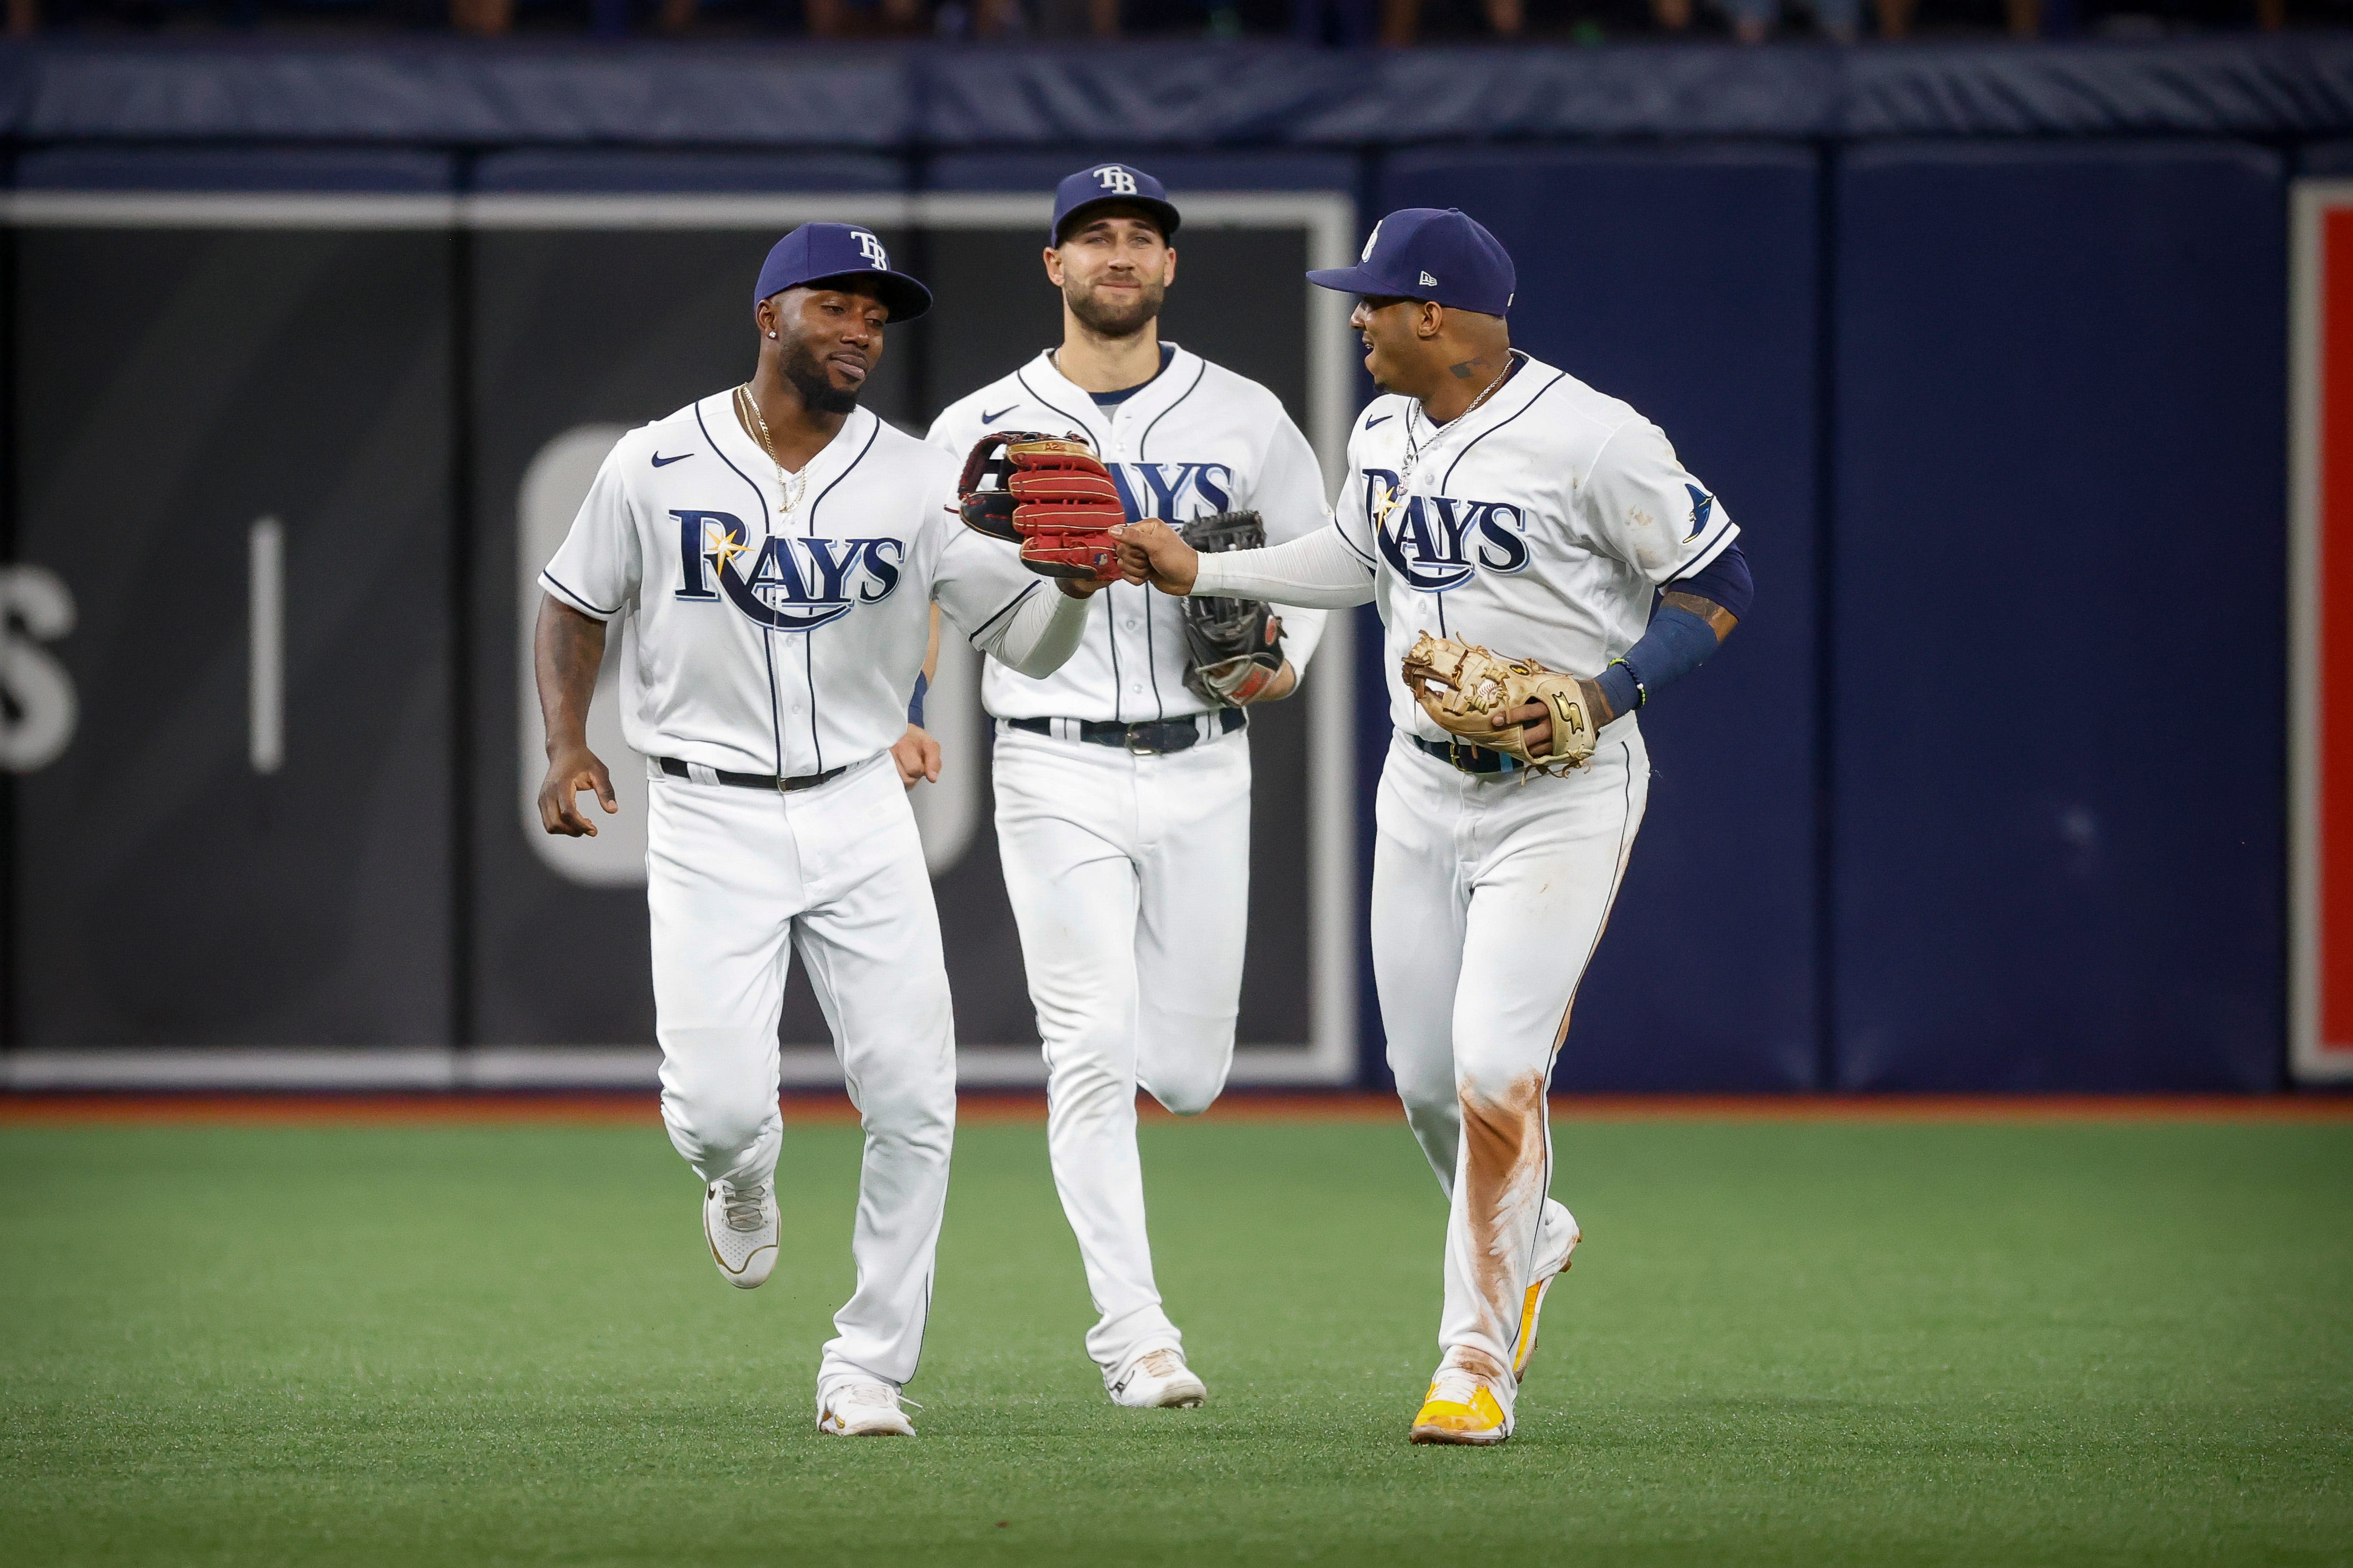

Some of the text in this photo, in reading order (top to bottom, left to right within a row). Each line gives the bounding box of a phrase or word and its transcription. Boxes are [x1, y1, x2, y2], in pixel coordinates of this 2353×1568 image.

[1093, 166, 1137, 194] TB
[850, 231, 887, 271] TB
[669, 509, 905, 631] RAYS
[1362, 469, 1530, 593] RAYS
